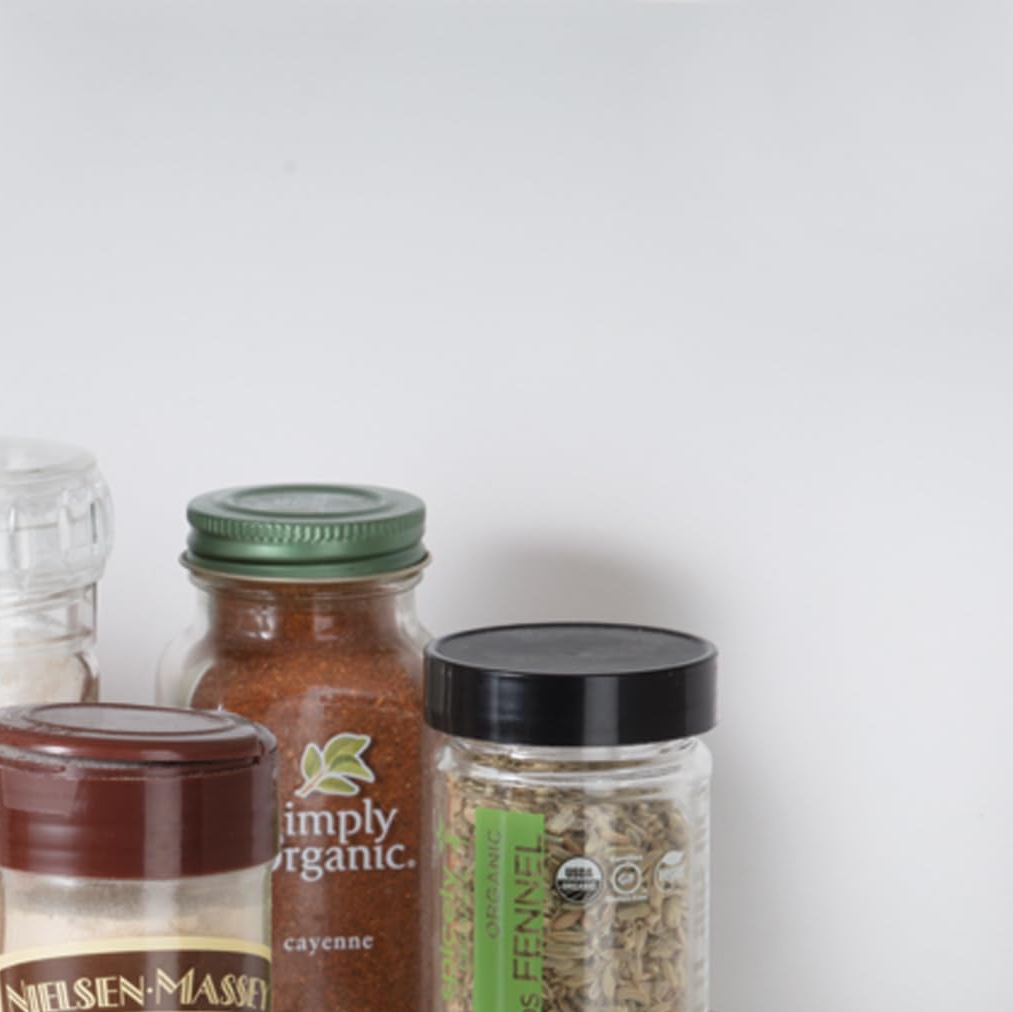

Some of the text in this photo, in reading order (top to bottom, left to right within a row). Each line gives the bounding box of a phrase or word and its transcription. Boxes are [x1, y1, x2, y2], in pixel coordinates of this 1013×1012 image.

[280, 798, 399, 845] imply
[486, 829, 502, 939] ORGANIC
[512, 834, 543, 981] FENNEL
[283, 934, 374, 956] cayenne
